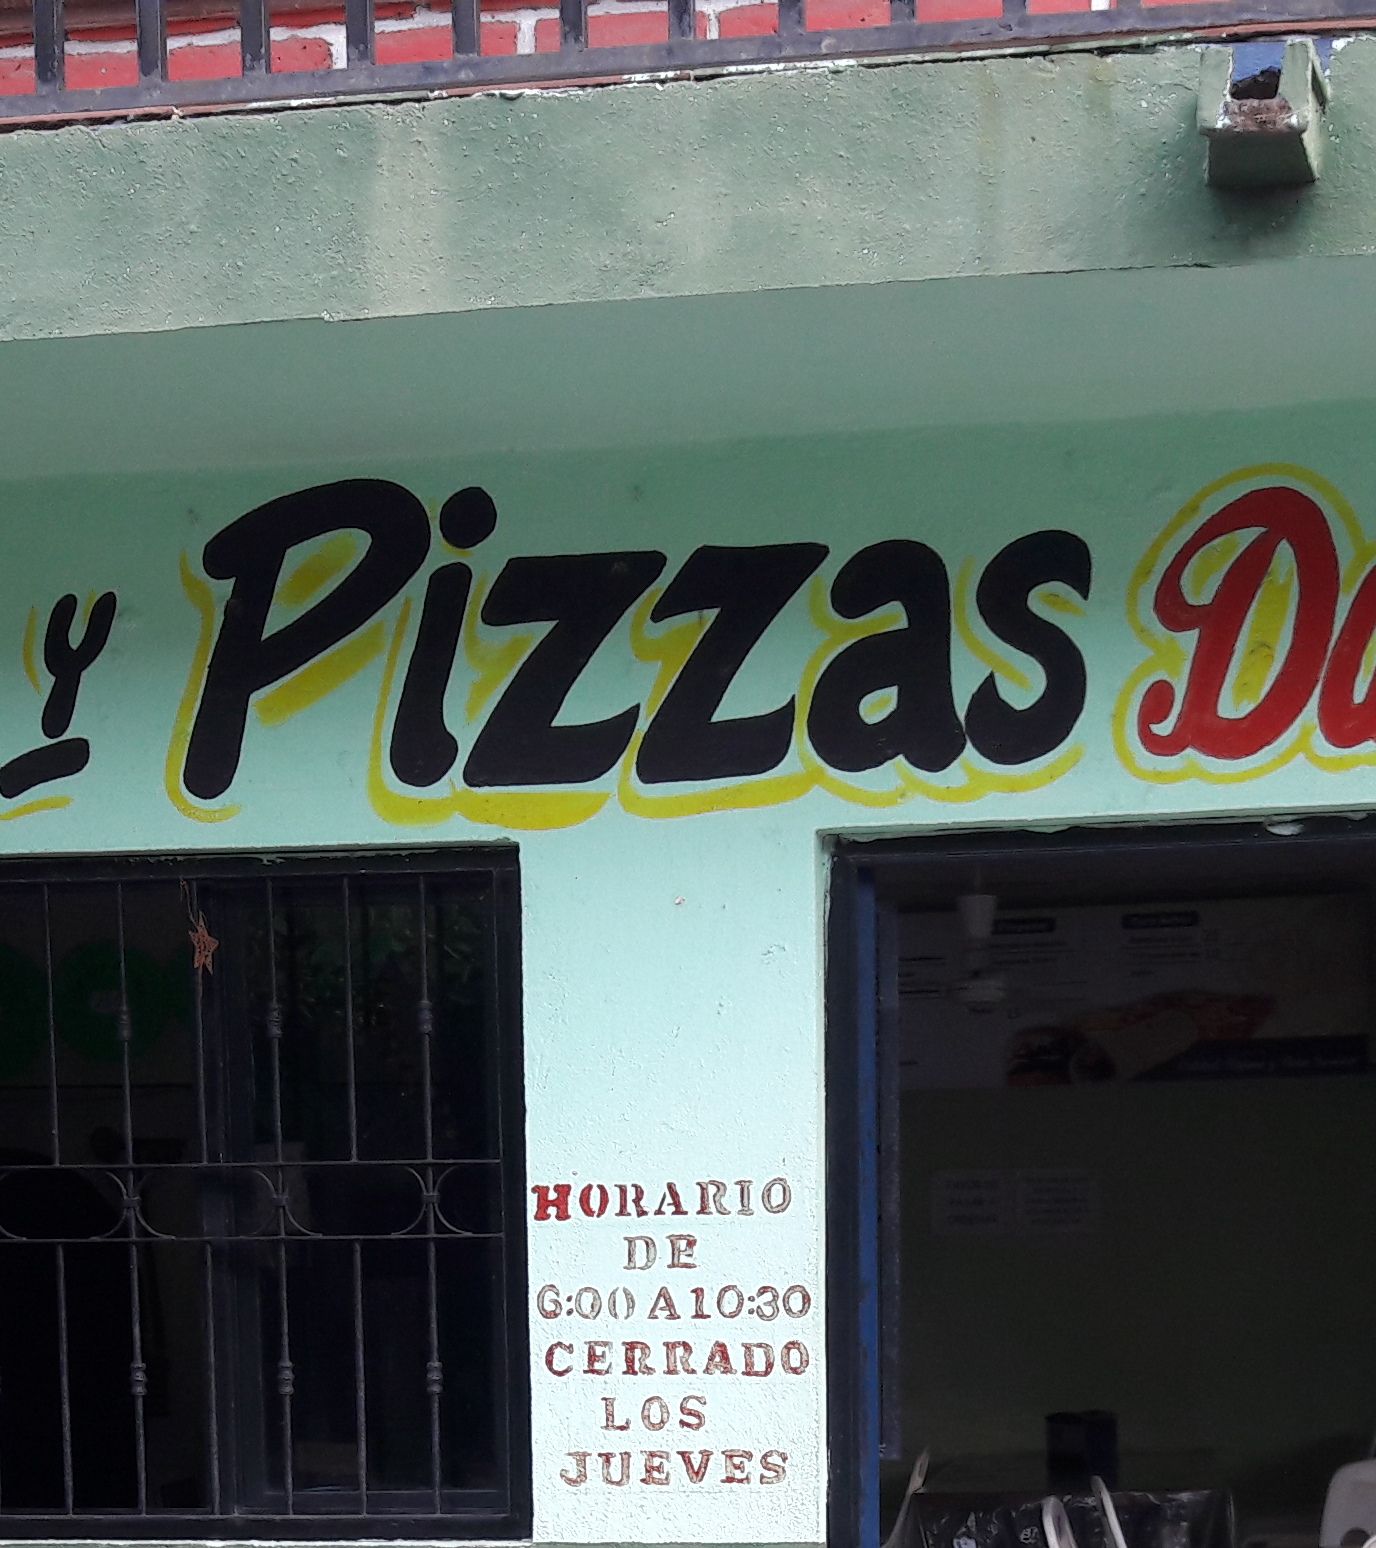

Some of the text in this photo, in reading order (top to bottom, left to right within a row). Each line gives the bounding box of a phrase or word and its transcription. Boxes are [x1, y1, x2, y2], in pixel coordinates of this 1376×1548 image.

[182, 477, 1091, 801] Pizzas
[531, 1177, 792, 1221] HORARIO
[623, 1234, 699, 1271] DE
[536, 1283, 636, 1321] 6:00
[544, 1340, 810, 1378] CERRADO
[600, 1395, 707, 1431] LOS
[559, 1449, 789, 1487] JUEVES
